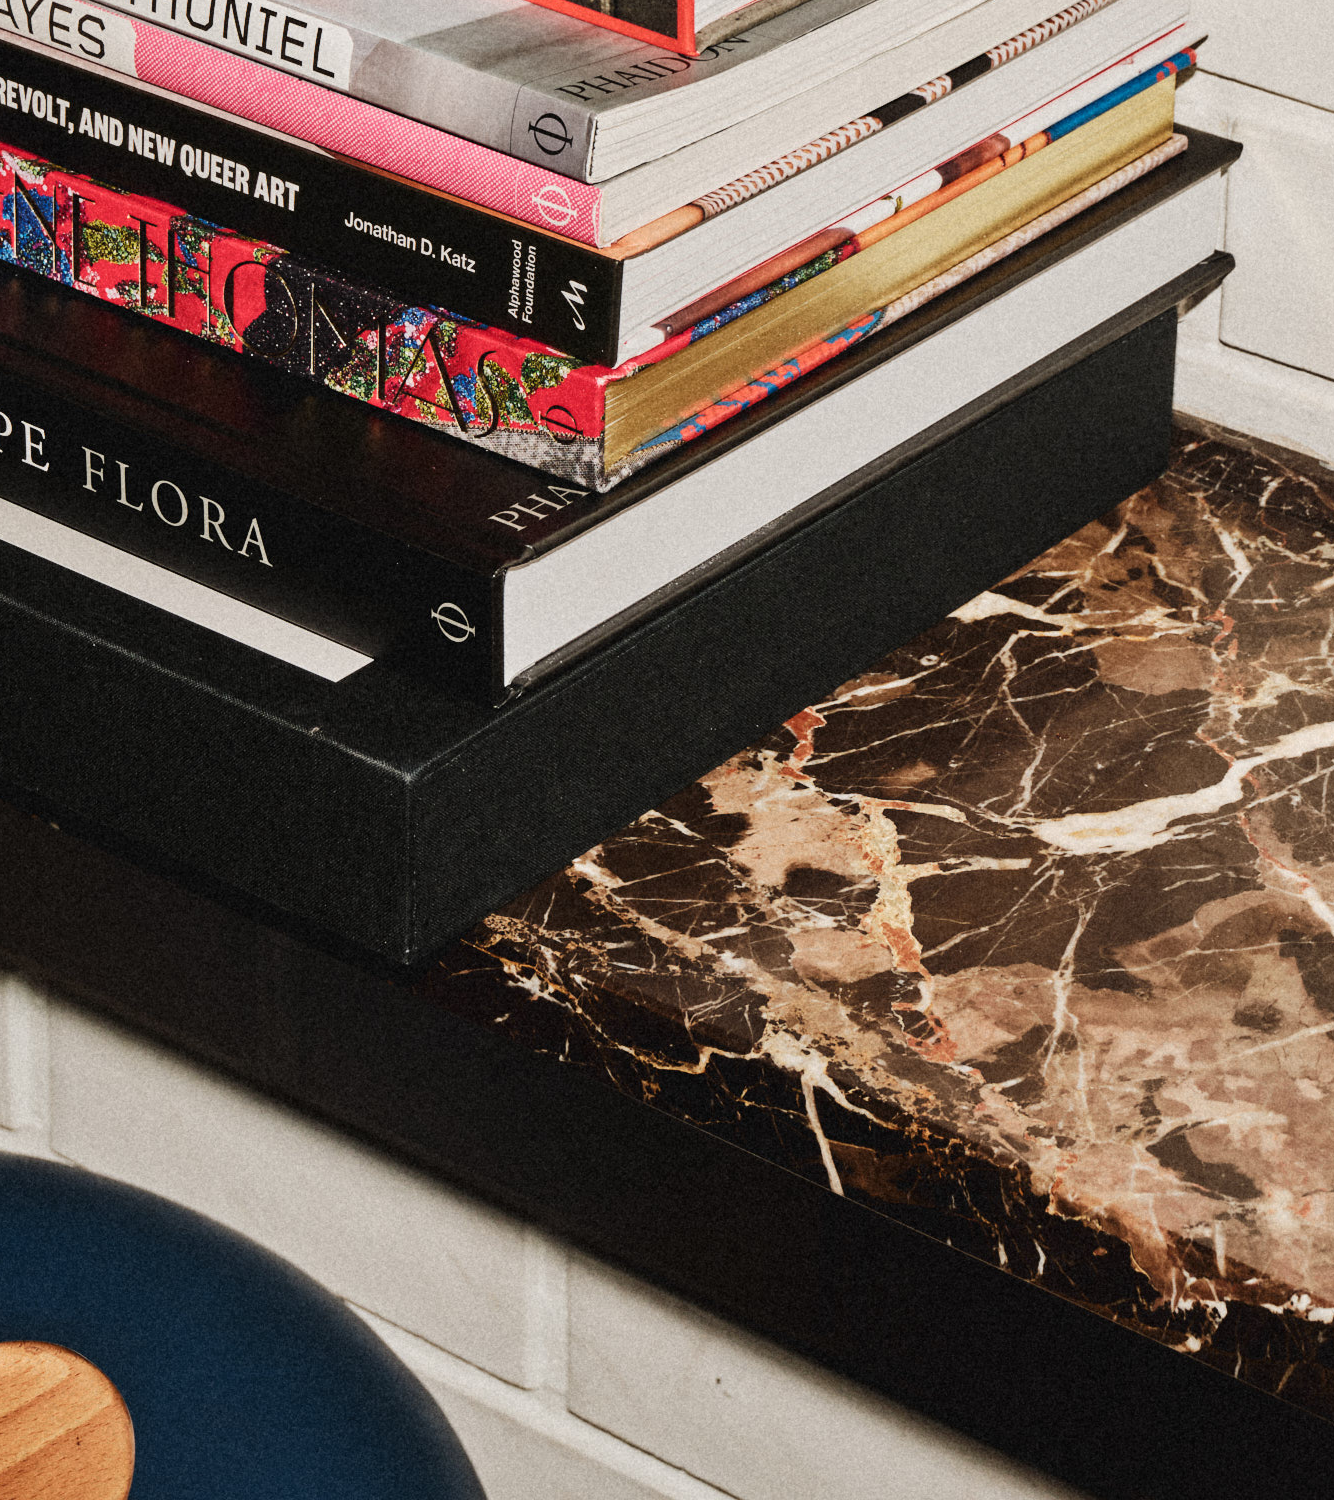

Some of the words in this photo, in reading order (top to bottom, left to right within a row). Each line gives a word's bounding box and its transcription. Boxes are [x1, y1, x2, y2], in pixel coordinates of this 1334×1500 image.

[78, 106, 123, 149] AND
[128, 122, 176, 167] NEW
[179, 138, 249, 195] QUEER
[254, 172, 300, 211] ART
[344, 211, 418, 252] Jonathan
[420, 234, 437, 258] D.
[441, 247, 477, 274] Katz
[508, 240, 522, 319] Alphawood
[522, 245, 536, 324] Foundation
[128, 215, 498, 438] THOMAS
[81, 445, 274, 567] FLORA
